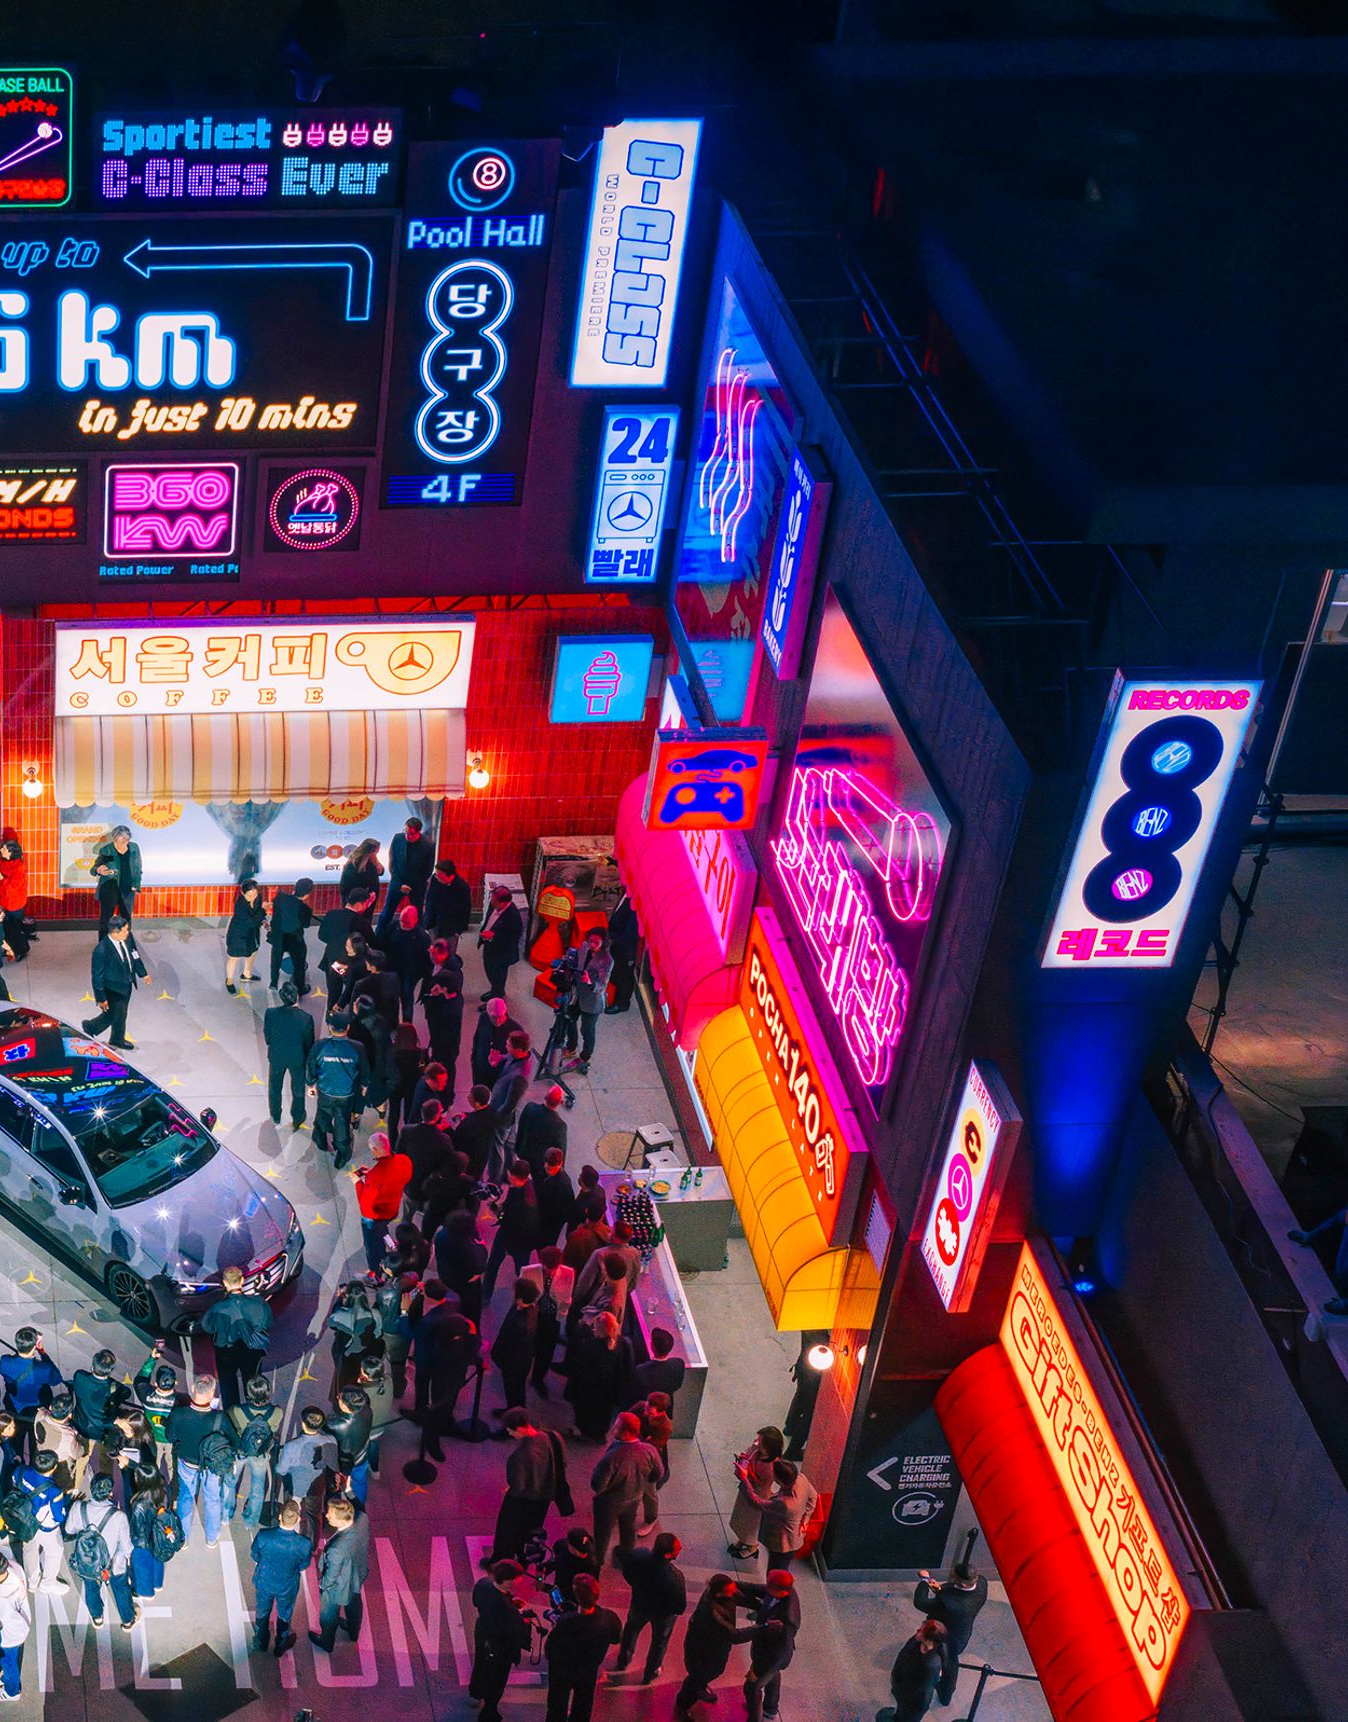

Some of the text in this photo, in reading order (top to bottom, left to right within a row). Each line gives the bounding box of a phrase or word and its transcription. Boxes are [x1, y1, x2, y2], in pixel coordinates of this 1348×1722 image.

[29, 77, 64, 92] BALL
[103, 117, 271, 156] Sportiest
[102, 157, 389, 198] C-Class Ever
[407, 214, 545, 249] Pool Hall
[1, 238, 50, 276] up
[55, 237, 100, 269] to
[587, 174, 619, 337] WORLD PREMIERE
[57, 289, 236, 391] km
[436, 283, 492, 444] 당구장
[78, 396, 358, 440] in just 10 mins
[607, 417, 672, 465] 24
[113, 512, 229, 551] KW
[99, 566, 133, 576] Rated
[136, 565, 174, 576] Power
[190, 564, 224, 575] Rated
[592, 549, 655, 578] 빨래
[762, 619, 782, 667] BAKERY
[69, 686, 324, 709] COFFEE
[1127, 689, 1251, 711] RECORDS
[131, 812, 180, 828] GOOD DAY
[322, 808, 349, 824] GOOD
[1135, 807, 1169, 837] BENZ
[1115, 869, 1149, 899] BENZ
[1056, 928, 1170, 961] 레코드
[969, 1067, 1000, 1132] CURRENCY
[923, 1238, 950, 1304] EXCHANGE
[1021, 1263, 1119, 1487] MERCEDES-BENZ
[899, 1473, 950, 1482] CHARGING
[902, 1465, 943, 1473] VEHICLE
[903, 1455, 951, 1464] ELECTRIC
[1010, 1290, 1167, 1671] Gift Shop
[1116, 1485, 1163, 1595] 기프트
